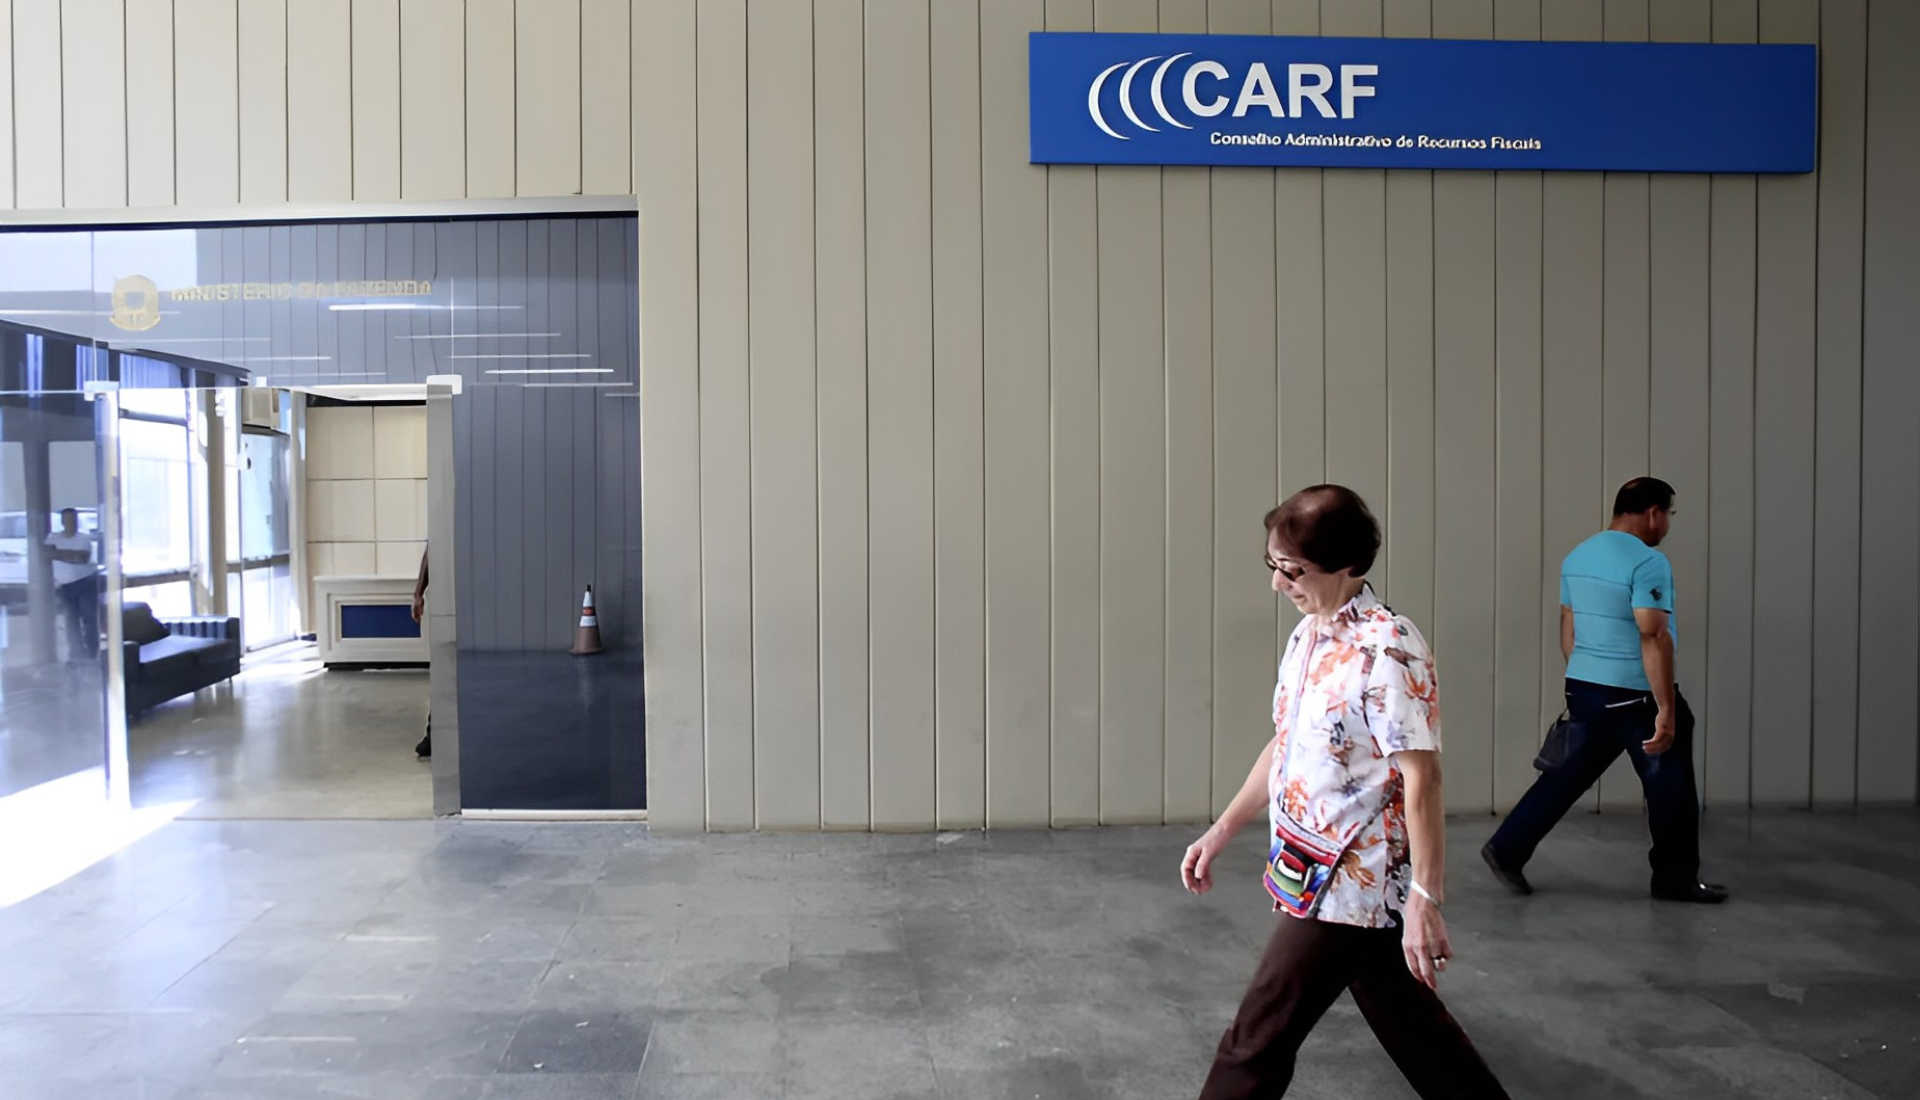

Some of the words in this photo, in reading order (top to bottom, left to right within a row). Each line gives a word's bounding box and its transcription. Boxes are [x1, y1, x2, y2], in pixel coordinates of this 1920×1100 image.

[1181, 61, 1379, 119] CARF
[1210, 131, 1282, 146] Conselho
[1285, 133, 1392, 148] Administrativo
[1395, 135, 1414, 148] de
[1417, 135, 1487, 149] Recursos
[1491, 136, 1542, 150] Fiscais
